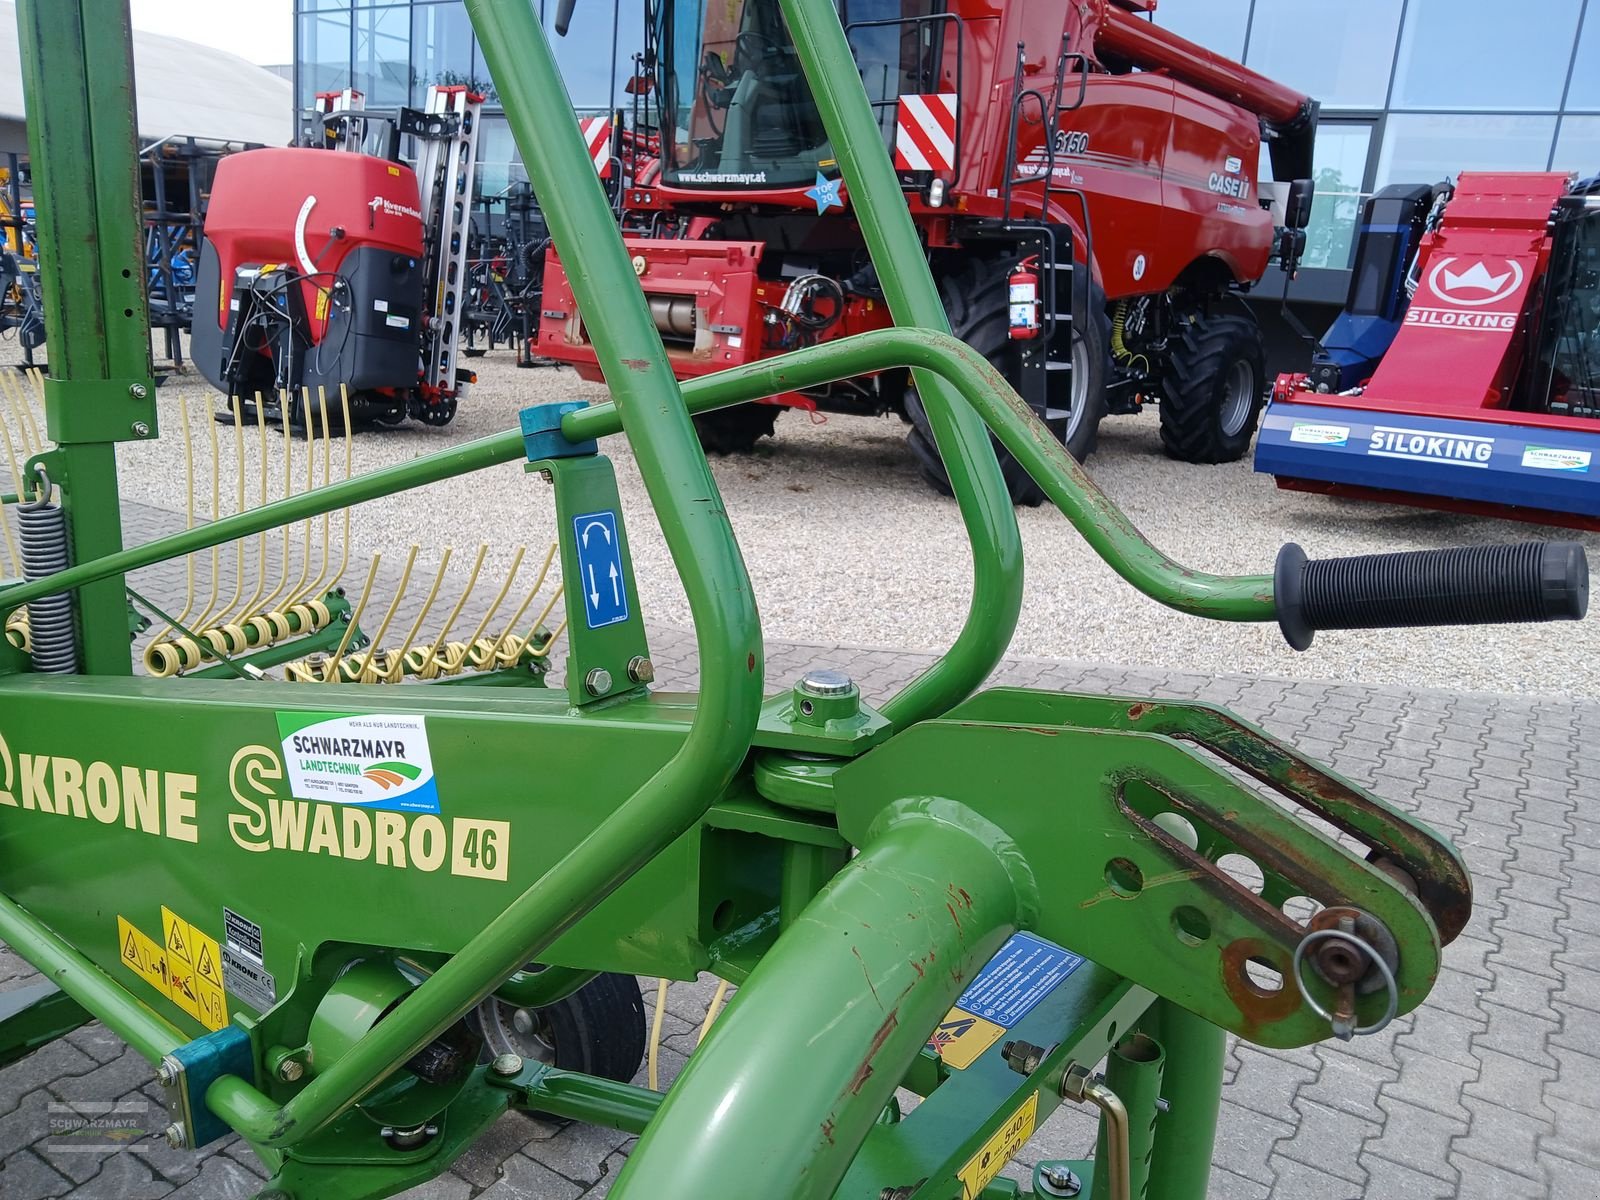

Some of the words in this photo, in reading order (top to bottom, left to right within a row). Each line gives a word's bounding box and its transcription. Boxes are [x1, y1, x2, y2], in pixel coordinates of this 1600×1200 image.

[678, 171, 767, 185] www.schwarzmayr.at
[815, 182, 834, 196] TOP
[821, 193, 834, 204] 20
[383, 199, 422, 220] Kverneland
[1405, 310, 1517, 329] SILOKING
[1368, 431, 1493, 463] SILOKING
[363, 721, 373, 729] ALS
[373, 721, 384, 729] NUR
[292, 735, 406, 760] SCHWARZMAYR
[299, 759, 363, 776] LANDTECHNIK
[19, 753, 198, 844] KRONE
[227, 744, 447, 873] SWADRO
[462, 827, 497, 871] 46
[231, 916, 252, 932] KRONE
[231, 958, 259, 981] KRONE
